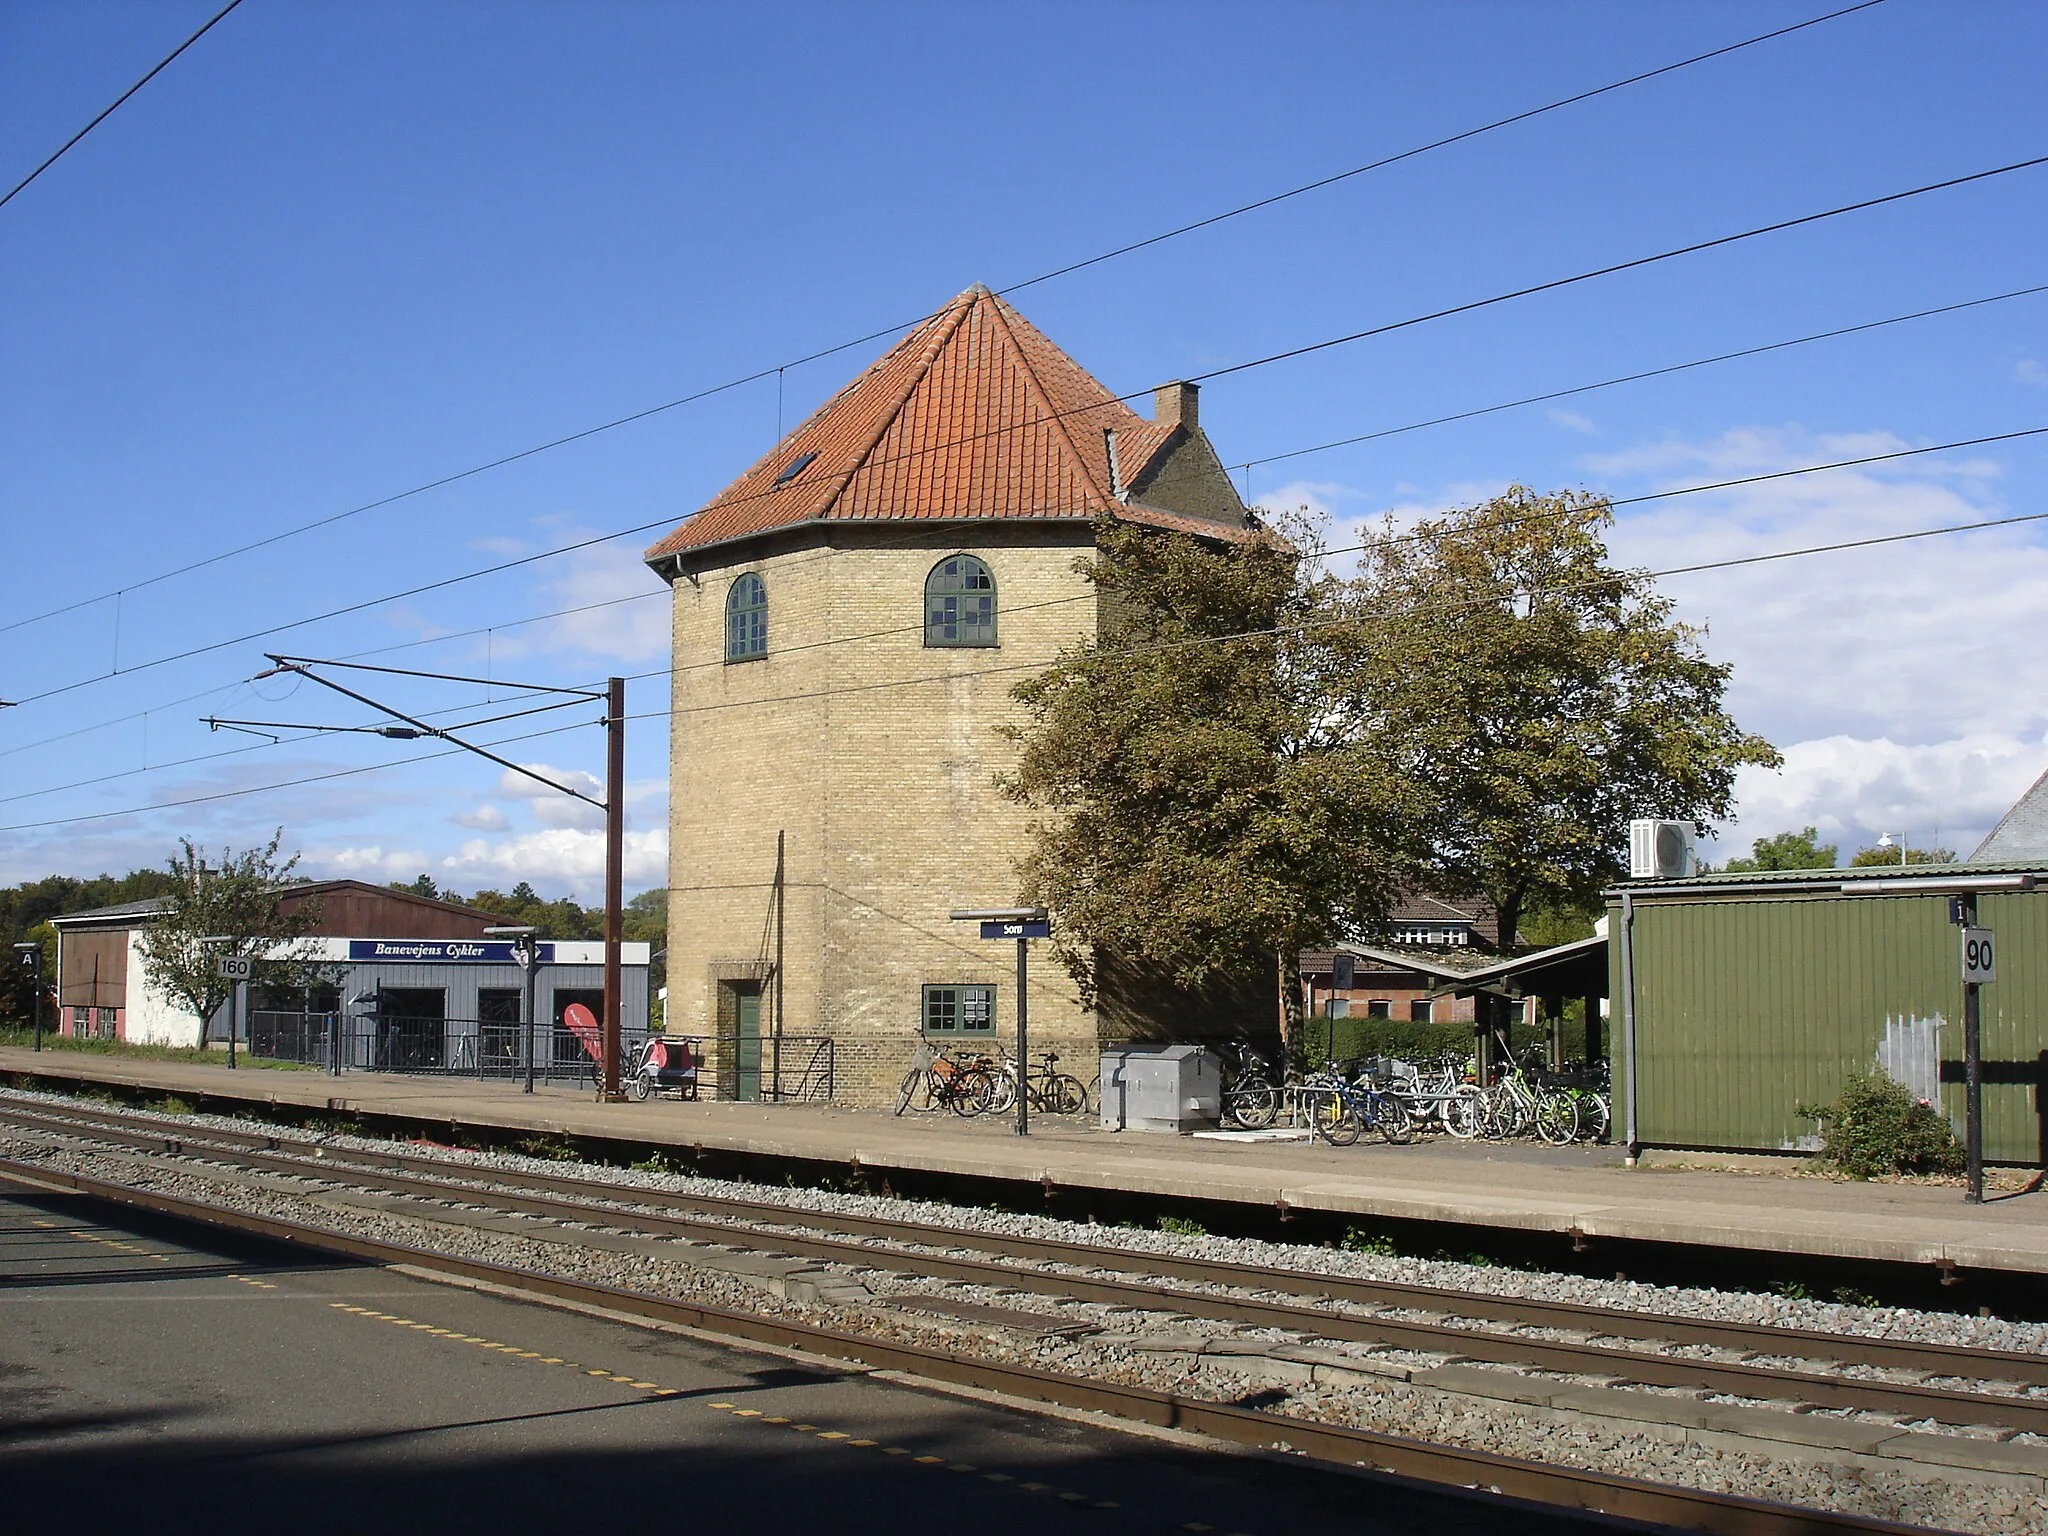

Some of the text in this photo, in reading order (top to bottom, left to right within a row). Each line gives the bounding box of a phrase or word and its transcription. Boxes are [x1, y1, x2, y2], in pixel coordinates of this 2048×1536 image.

[1957, 905, 1963, 920] 1
[374, 943, 485, 959] Banevejens Cykler
[519, 940, 524, 949] 1
[22, 953, 32, 965] A
[1967, 939, 1992, 971] 90
[221, 960, 248, 974] 160
